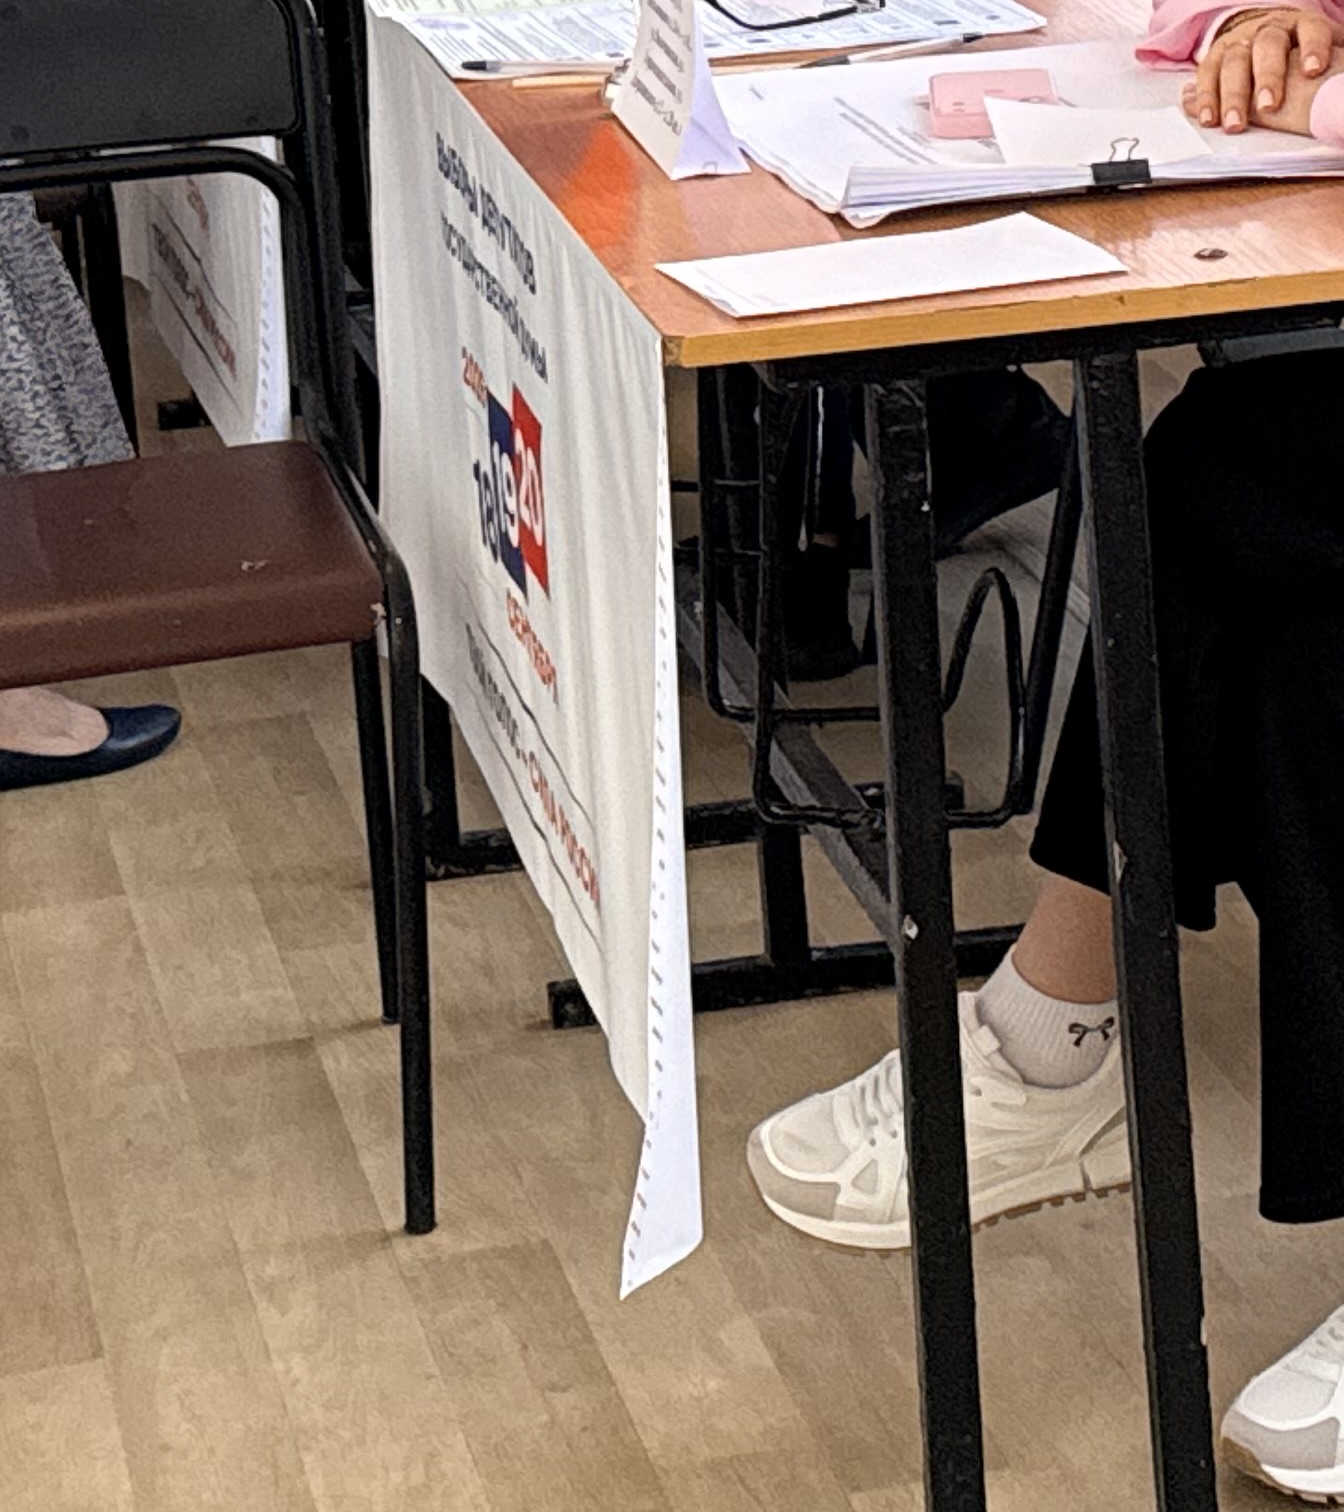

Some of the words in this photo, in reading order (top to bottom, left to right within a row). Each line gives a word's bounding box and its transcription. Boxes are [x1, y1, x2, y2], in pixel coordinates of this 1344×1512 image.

[473, 460, 500, 563] 18
[492, 440, 520, 550] 19
[513, 427, 545, 548] 20
